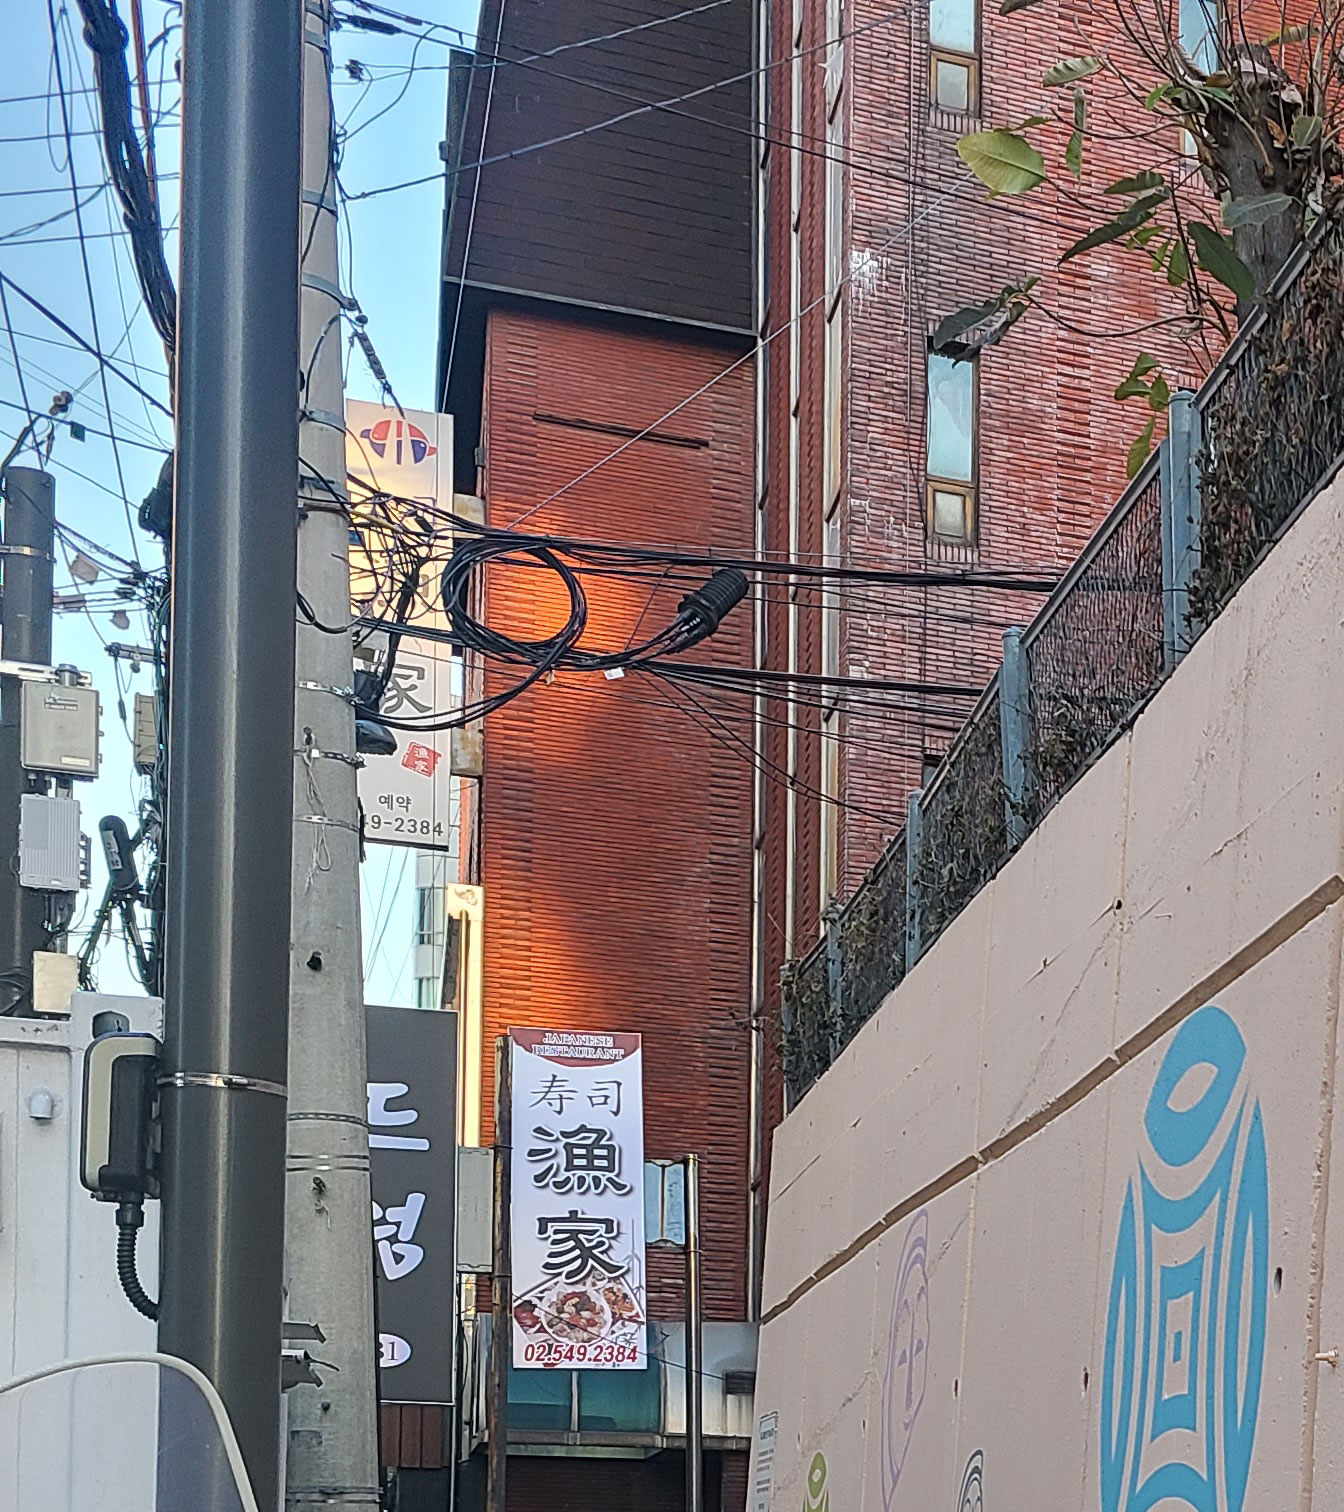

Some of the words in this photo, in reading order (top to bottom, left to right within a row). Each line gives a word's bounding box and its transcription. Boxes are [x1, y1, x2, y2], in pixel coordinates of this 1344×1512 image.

[378, 794, 412, 813] 예약
[363, 814, 444, 837] 9-2384
[543, 1033, 613, 1046] JAPANESE
[532, 1045, 624, 1059] RESTAURANT
[528, 1073, 622, 1117] 寿司
[526, 1123, 630, 1282] 漁家
[524, 1343, 638, 1363] 02.549.2384
